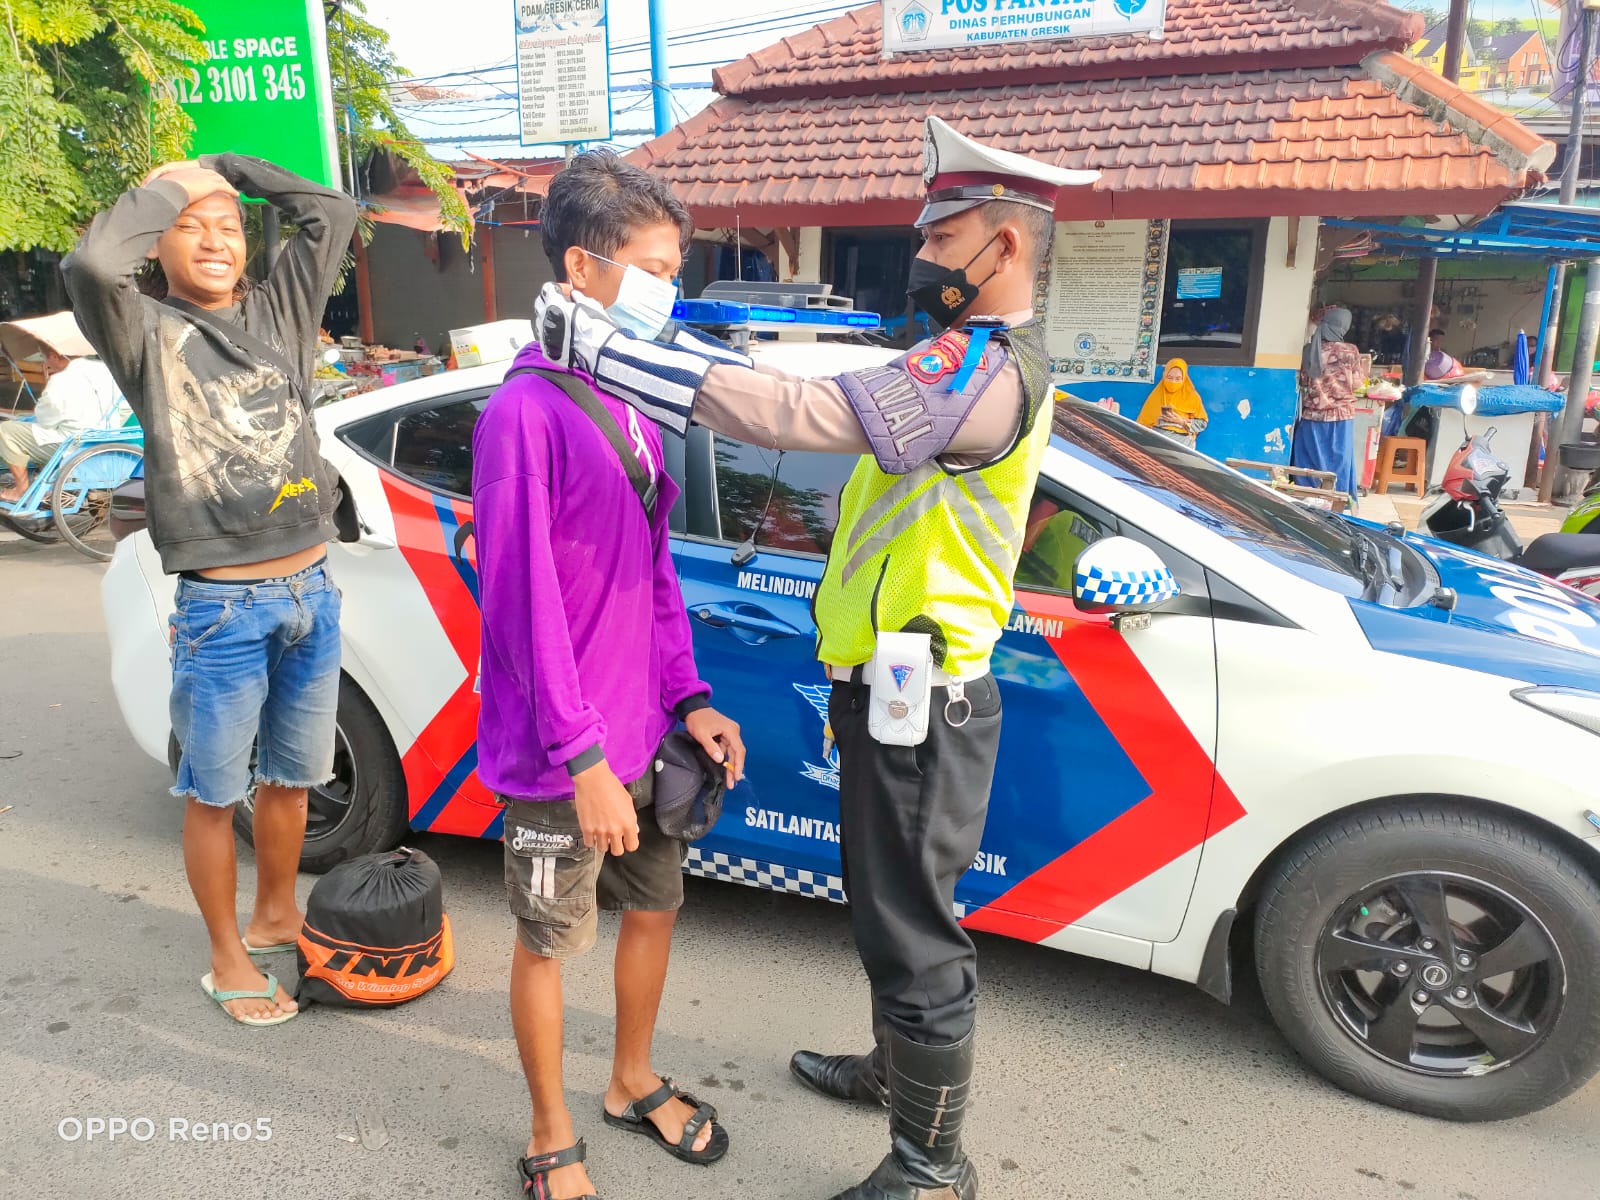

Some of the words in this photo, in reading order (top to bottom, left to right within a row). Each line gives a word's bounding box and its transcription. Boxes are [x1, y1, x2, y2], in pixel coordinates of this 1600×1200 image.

[521, 4, 542, 17] PDAM
[545, 1, 573, 14] GRESIK
[575, 0, 599, 12] CERIA
[949, 17, 987, 30] DINAS
[992, 8, 1092, 27] PERHUBUNGAN
[967, 28, 1028, 41] KABUPATEN
[1031, 24, 1071, 37] GRESIK
[233, 36, 298, 58] SPACE
[207, 65, 258, 103] 3101
[262, 64, 306, 101] 345
[969, 850, 1008, 877] SIK
[322, 939, 442, 978] INK
